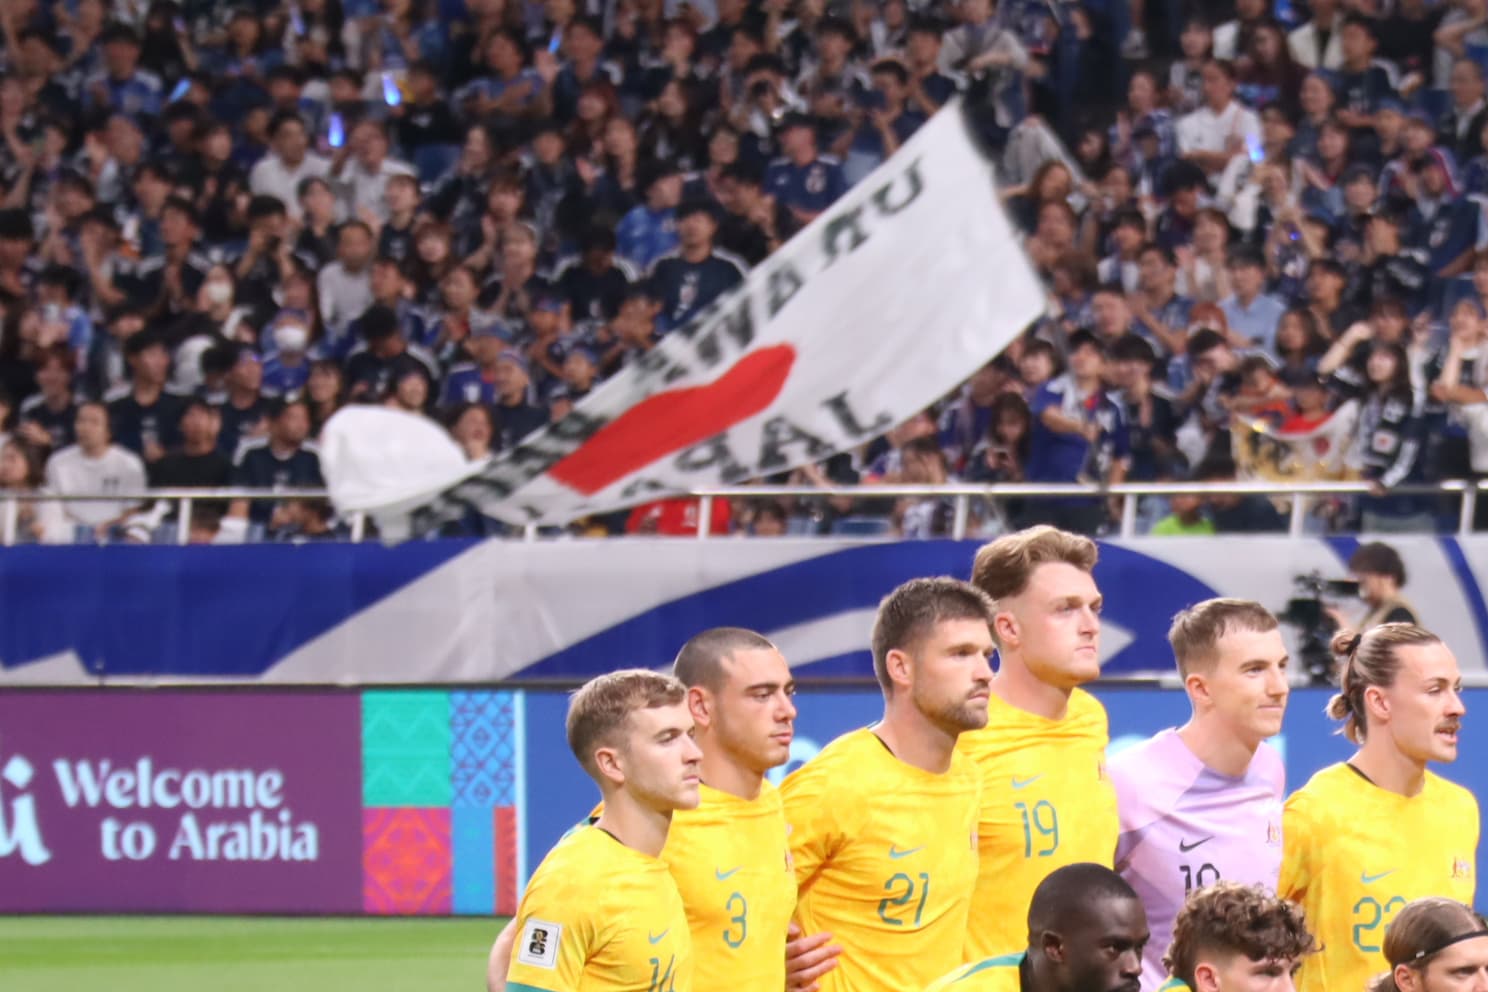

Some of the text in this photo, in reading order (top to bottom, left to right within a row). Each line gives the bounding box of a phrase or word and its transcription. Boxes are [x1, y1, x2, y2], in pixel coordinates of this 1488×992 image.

[53, 757, 284, 809] Welcome
[100, 809, 318, 861] to Arabia
[1014, 800, 1060, 858] 19
[722, 892, 748, 949] 3
[878, 872, 929, 928] 21
